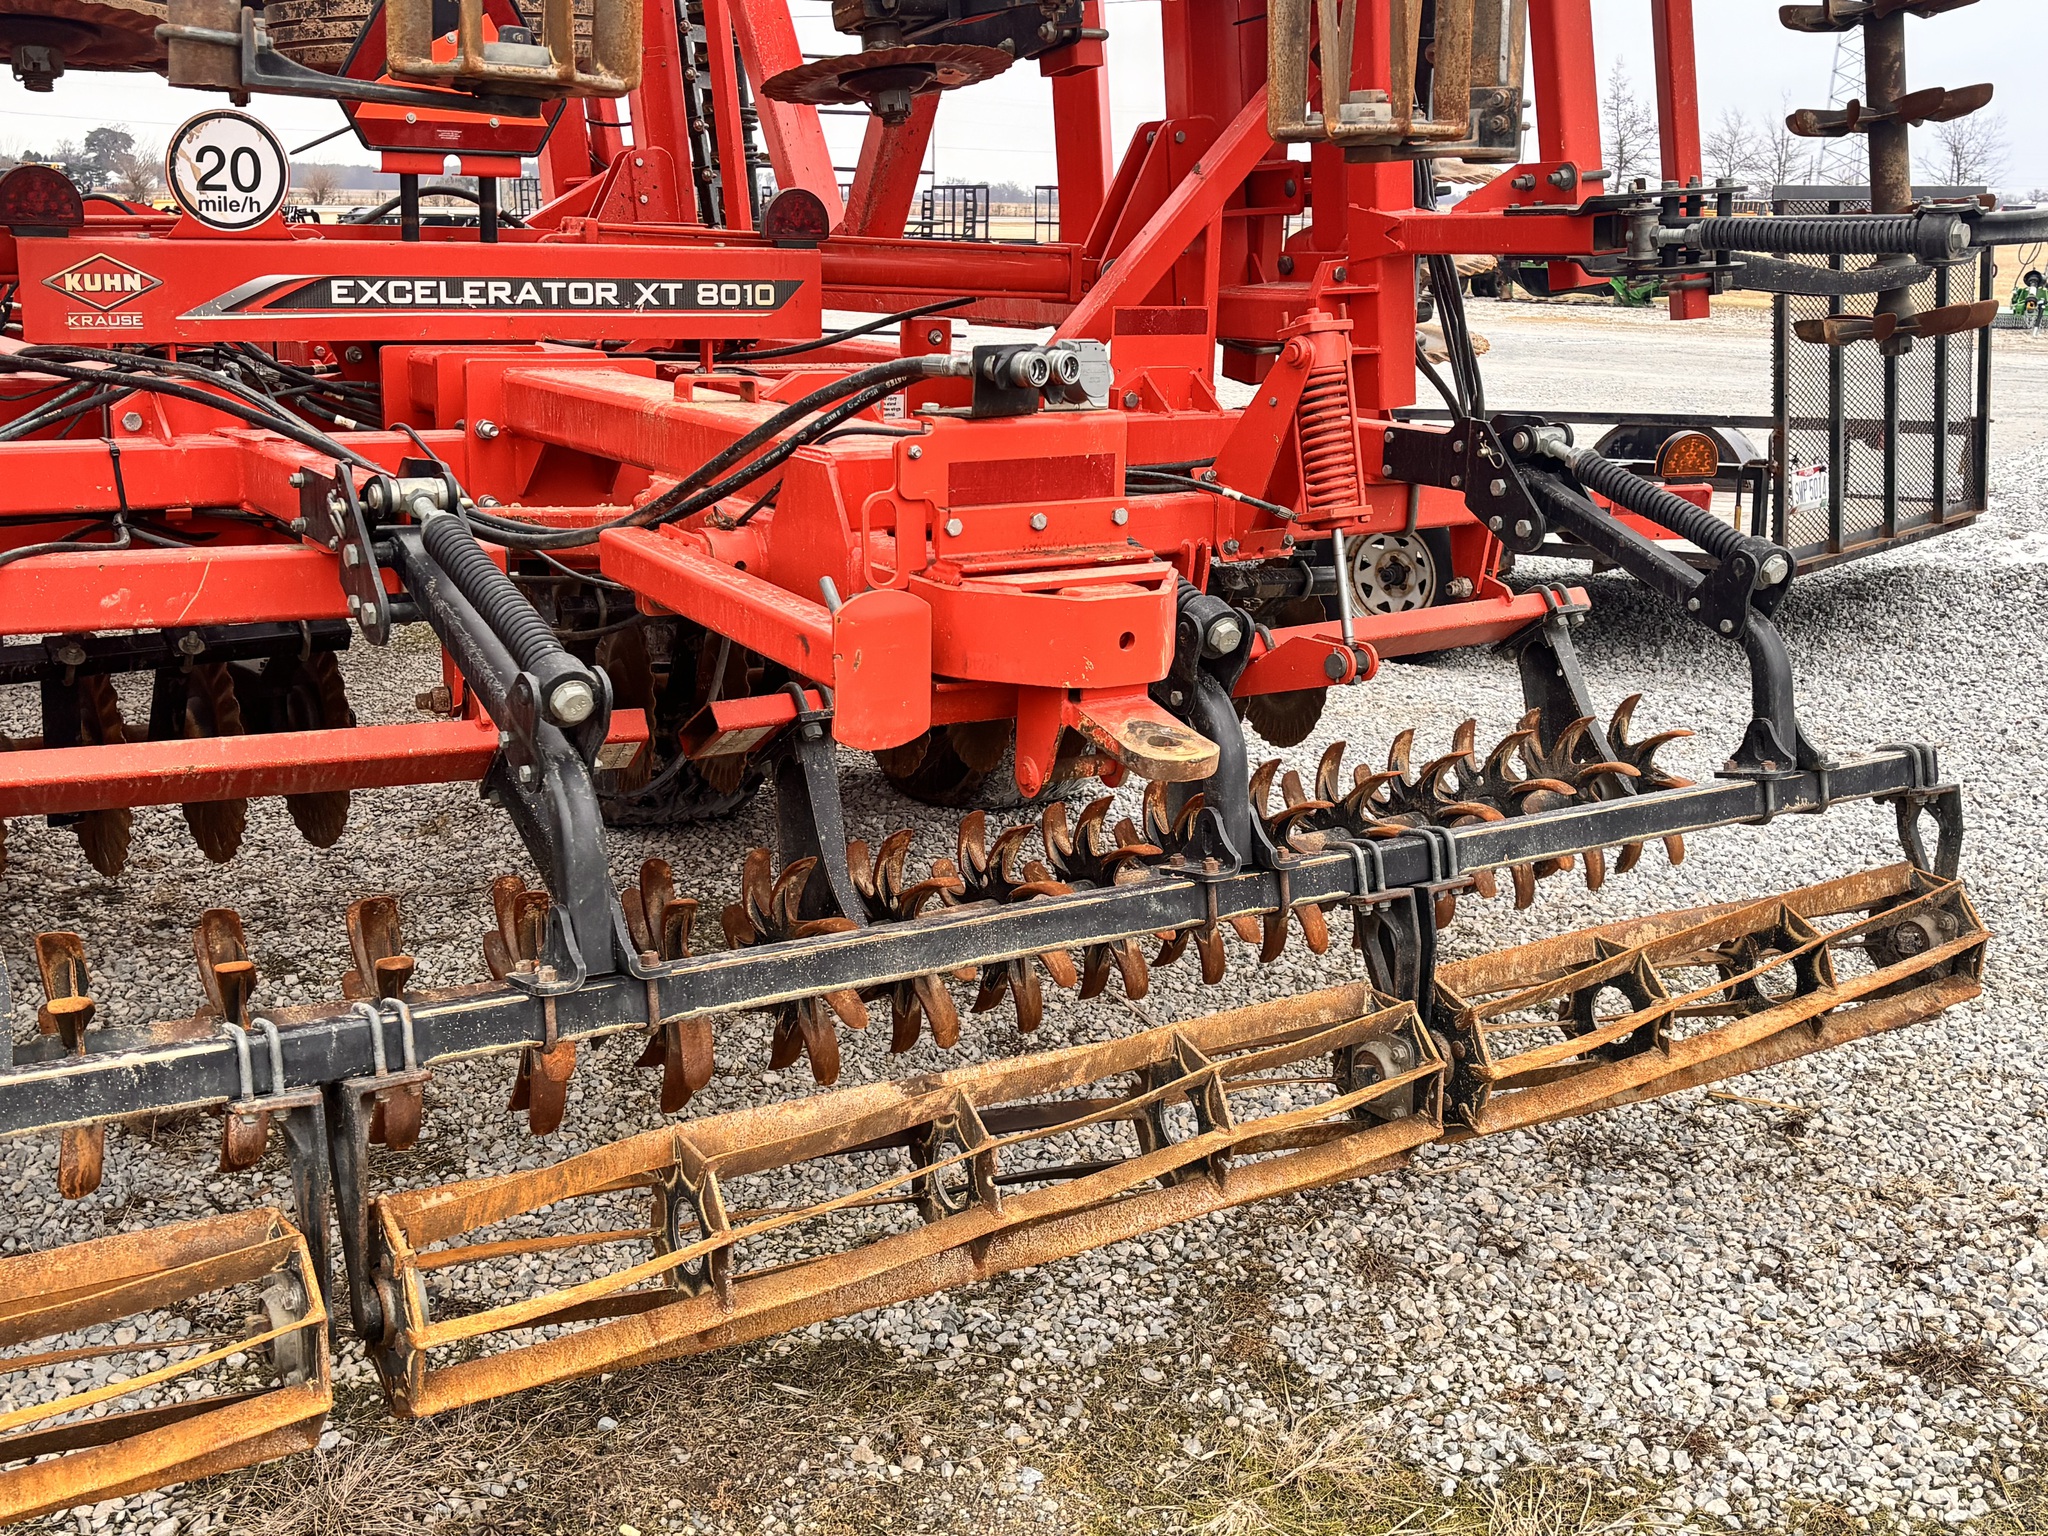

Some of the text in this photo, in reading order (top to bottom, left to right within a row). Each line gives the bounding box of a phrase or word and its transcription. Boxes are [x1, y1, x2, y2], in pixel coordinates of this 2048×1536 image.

[195, 145, 262, 194] 20
[198, 195, 261, 213] mile/h
[64, 273, 142, 292] KUHN
[330, 279, 776, 306] EXCELERATOR XT 8010
[68, 315, 143, 326] KRAUSE
